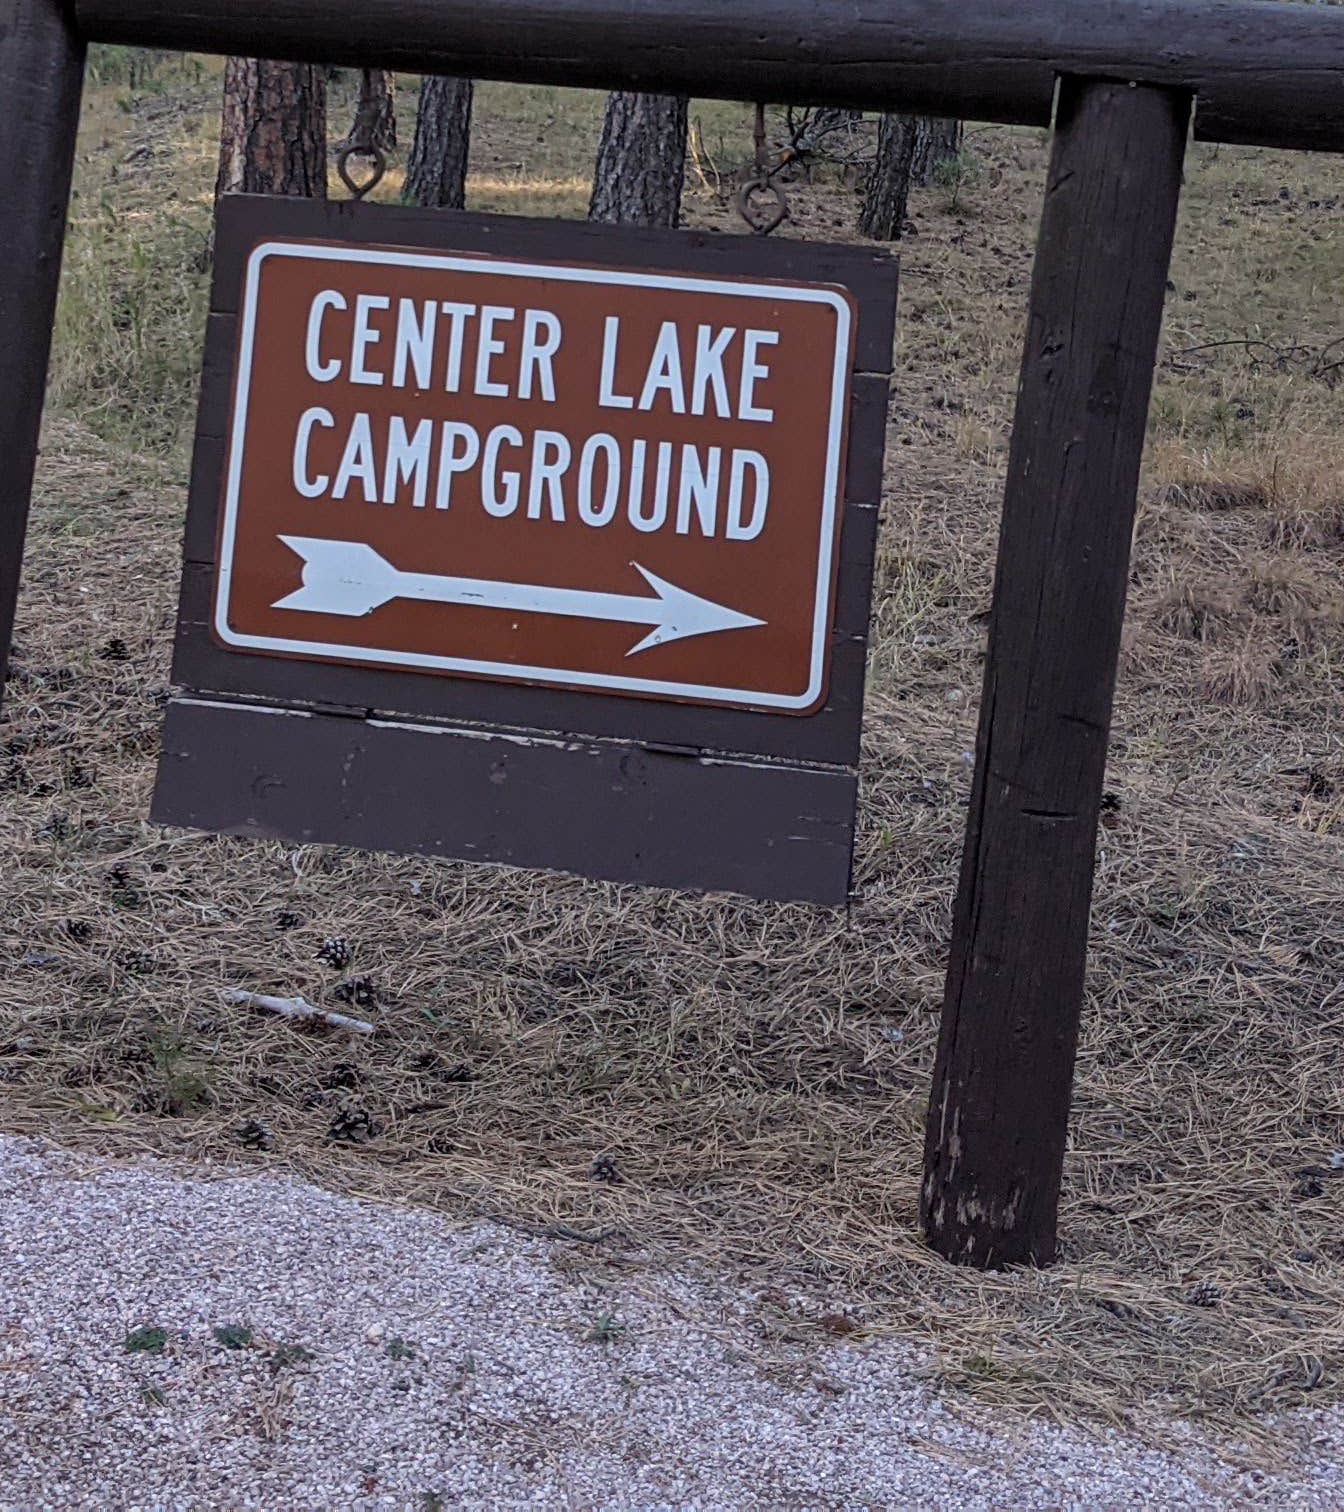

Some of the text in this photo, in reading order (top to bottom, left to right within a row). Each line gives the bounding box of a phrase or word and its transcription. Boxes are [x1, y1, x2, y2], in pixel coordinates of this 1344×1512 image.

[304, 289, 780, 423] CENTER LAKE
[292, 406, 771, 541] CAMPGROUND
